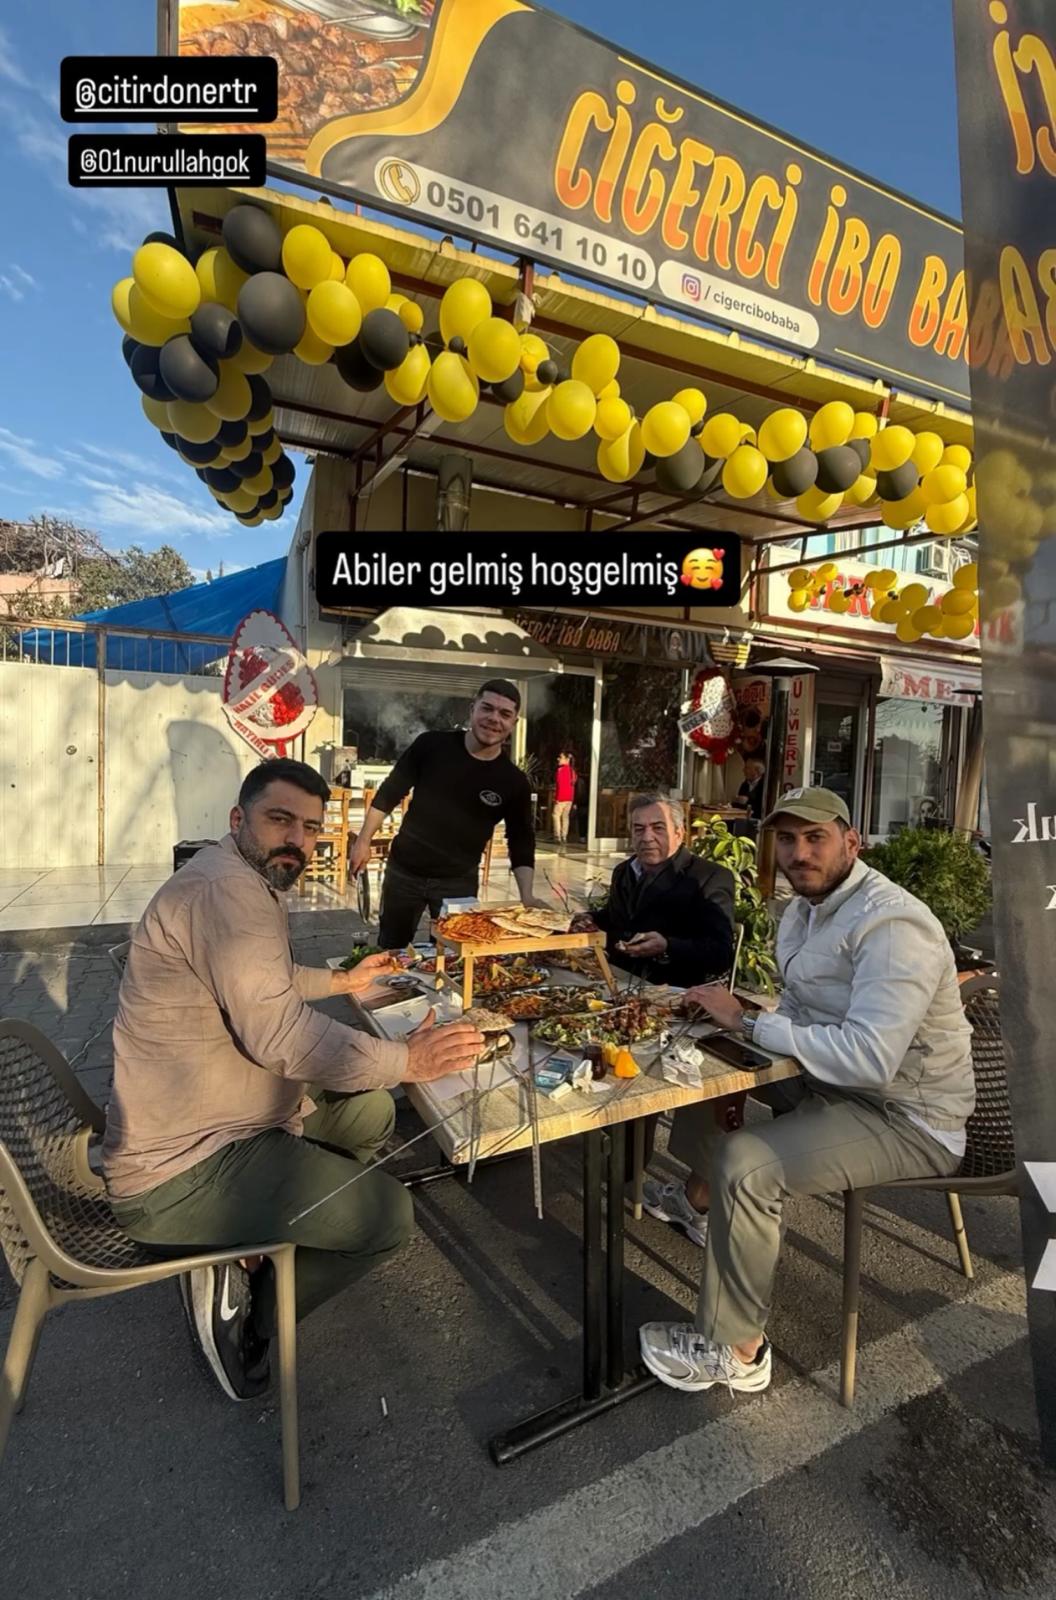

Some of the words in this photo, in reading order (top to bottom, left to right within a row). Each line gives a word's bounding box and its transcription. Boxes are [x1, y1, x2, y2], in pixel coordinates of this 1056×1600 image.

[427, 181, 500, 229] 0501
[514, 213, 563, 251] 641
[576, 237, 607, 267] 10
[617, 252, 647, 281] 10
[555, 80, 802, 289] CİĞERCİ
[808, 185, 901, 328] İBO
[713, 292, 800, 333] cigercibobaba
[557, 619, 582, 647] İBO
[586, 628, 620, 652] BABA
